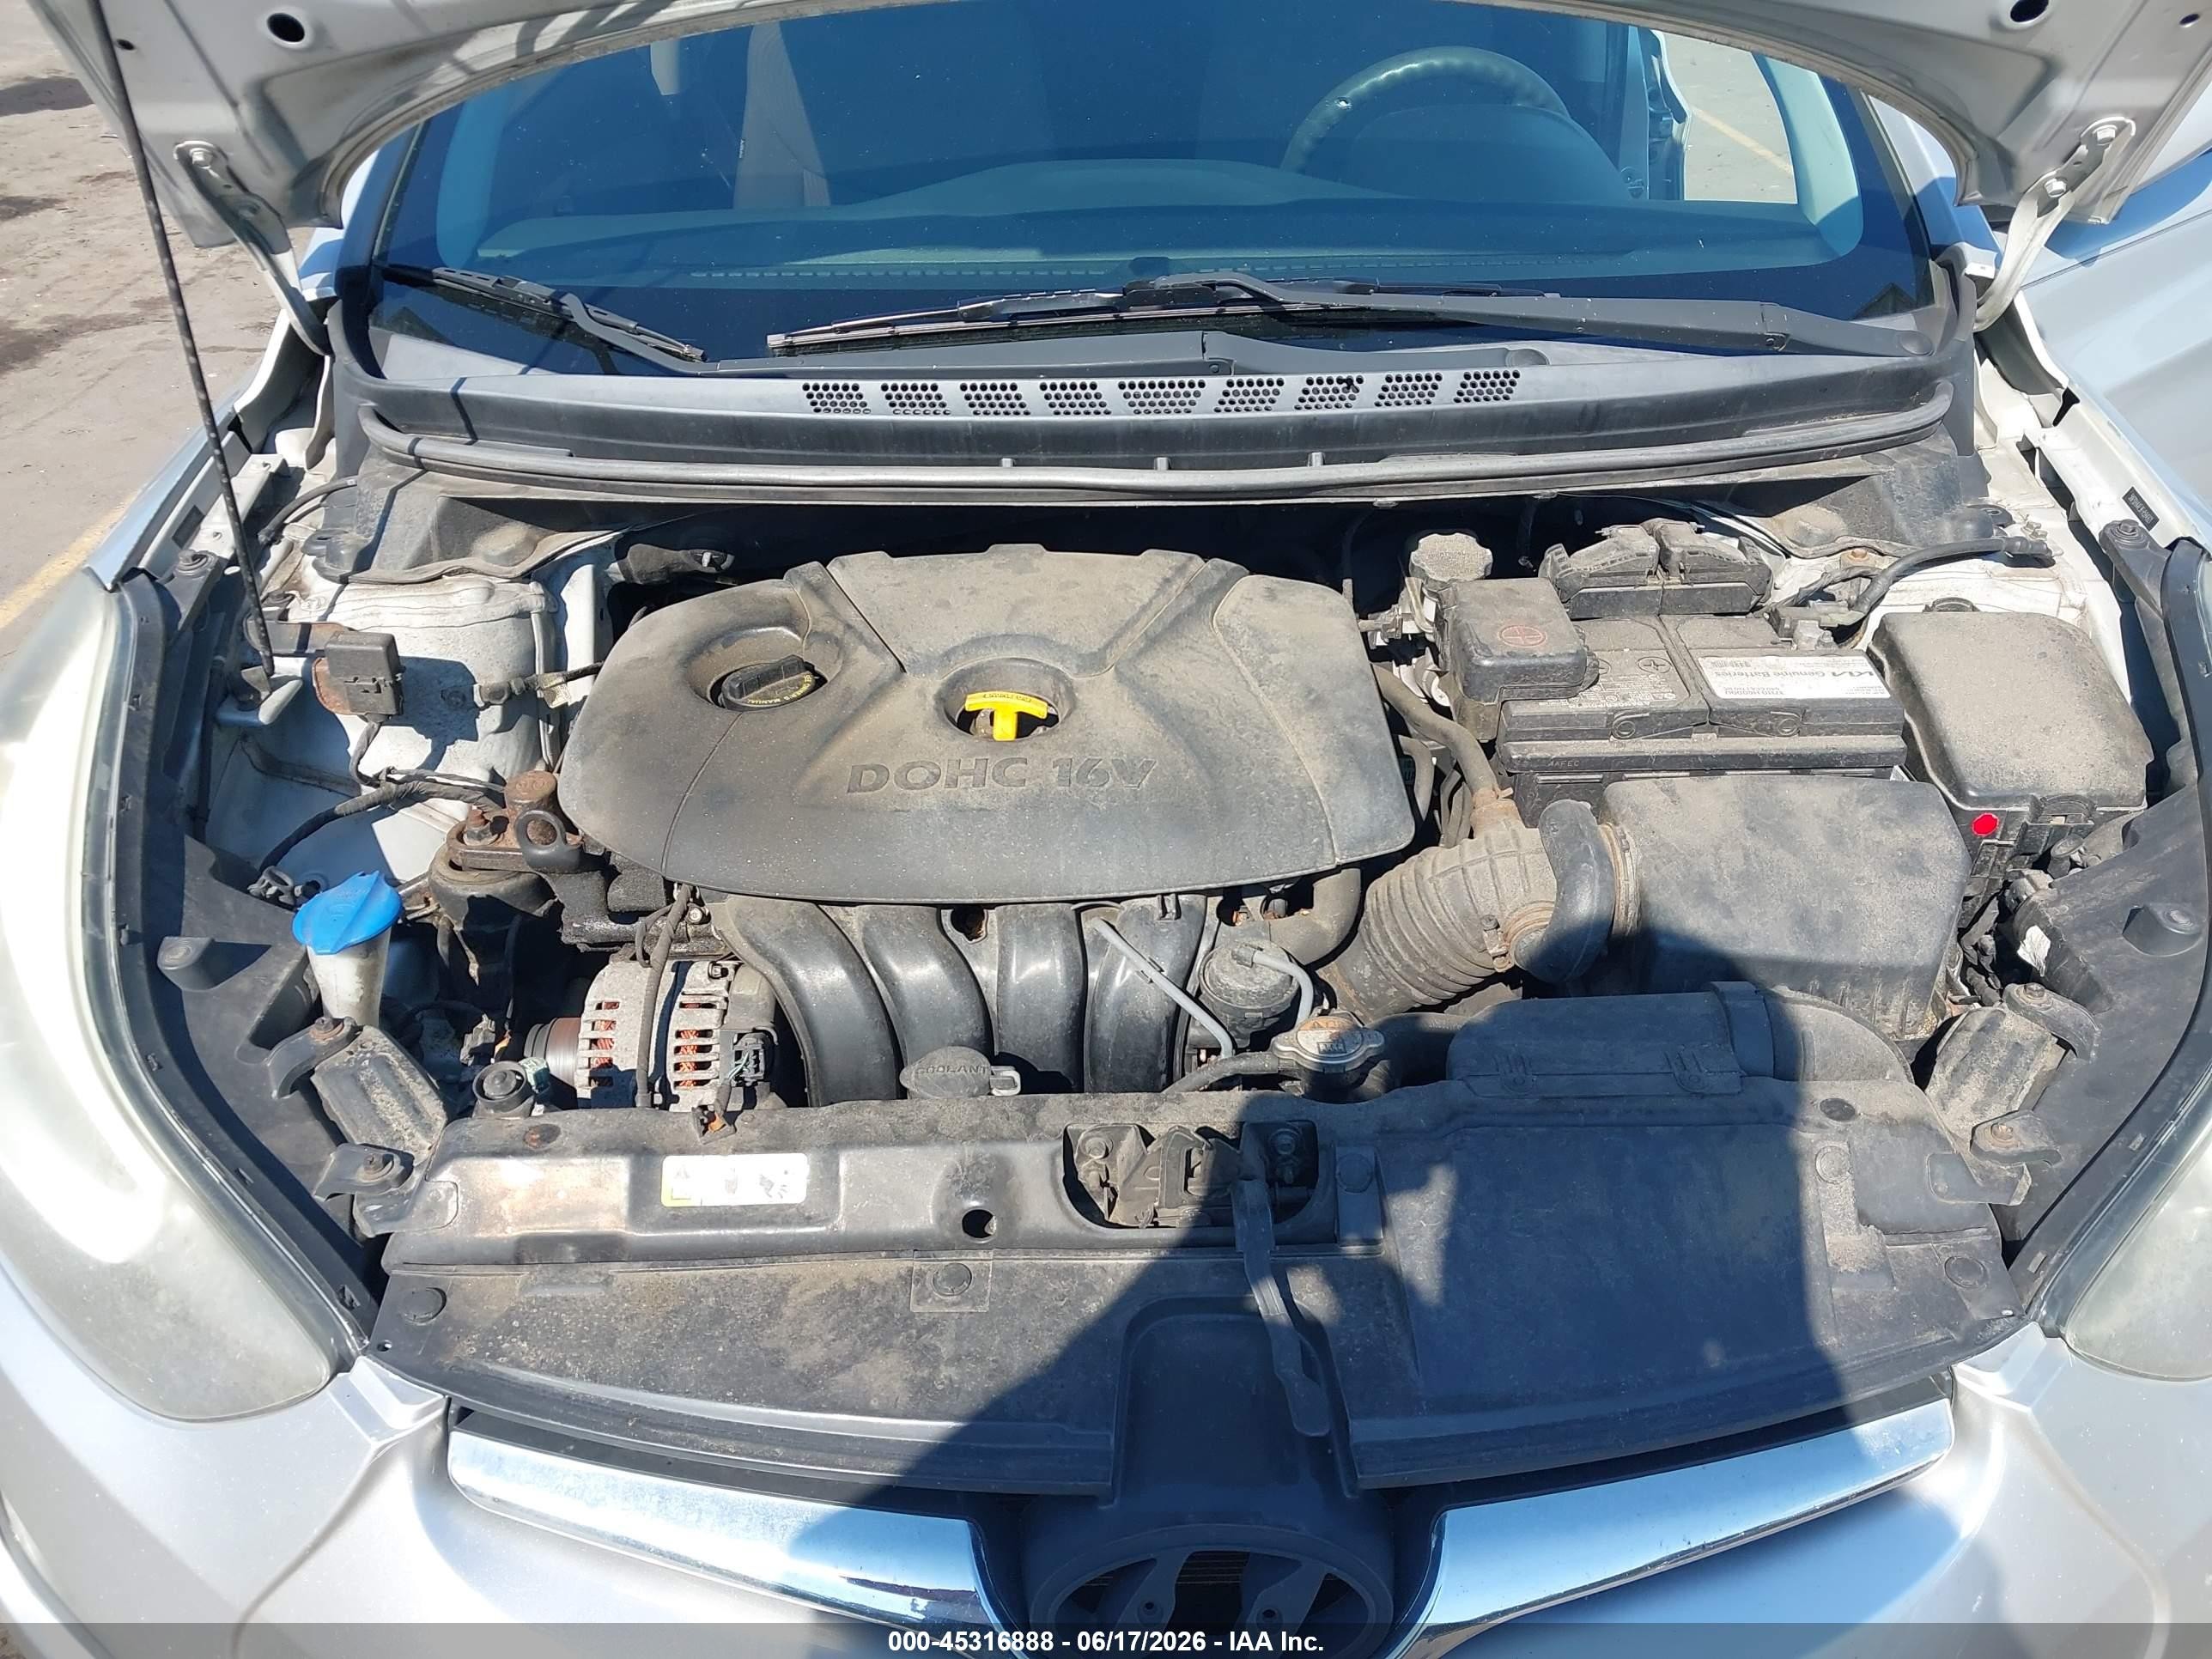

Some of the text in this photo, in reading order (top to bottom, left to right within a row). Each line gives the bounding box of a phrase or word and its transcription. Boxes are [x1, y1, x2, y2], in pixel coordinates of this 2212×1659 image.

[847, 757, 1158, 793] DOHC 16V
[916, 1064, 989, 1075] COOLANT
